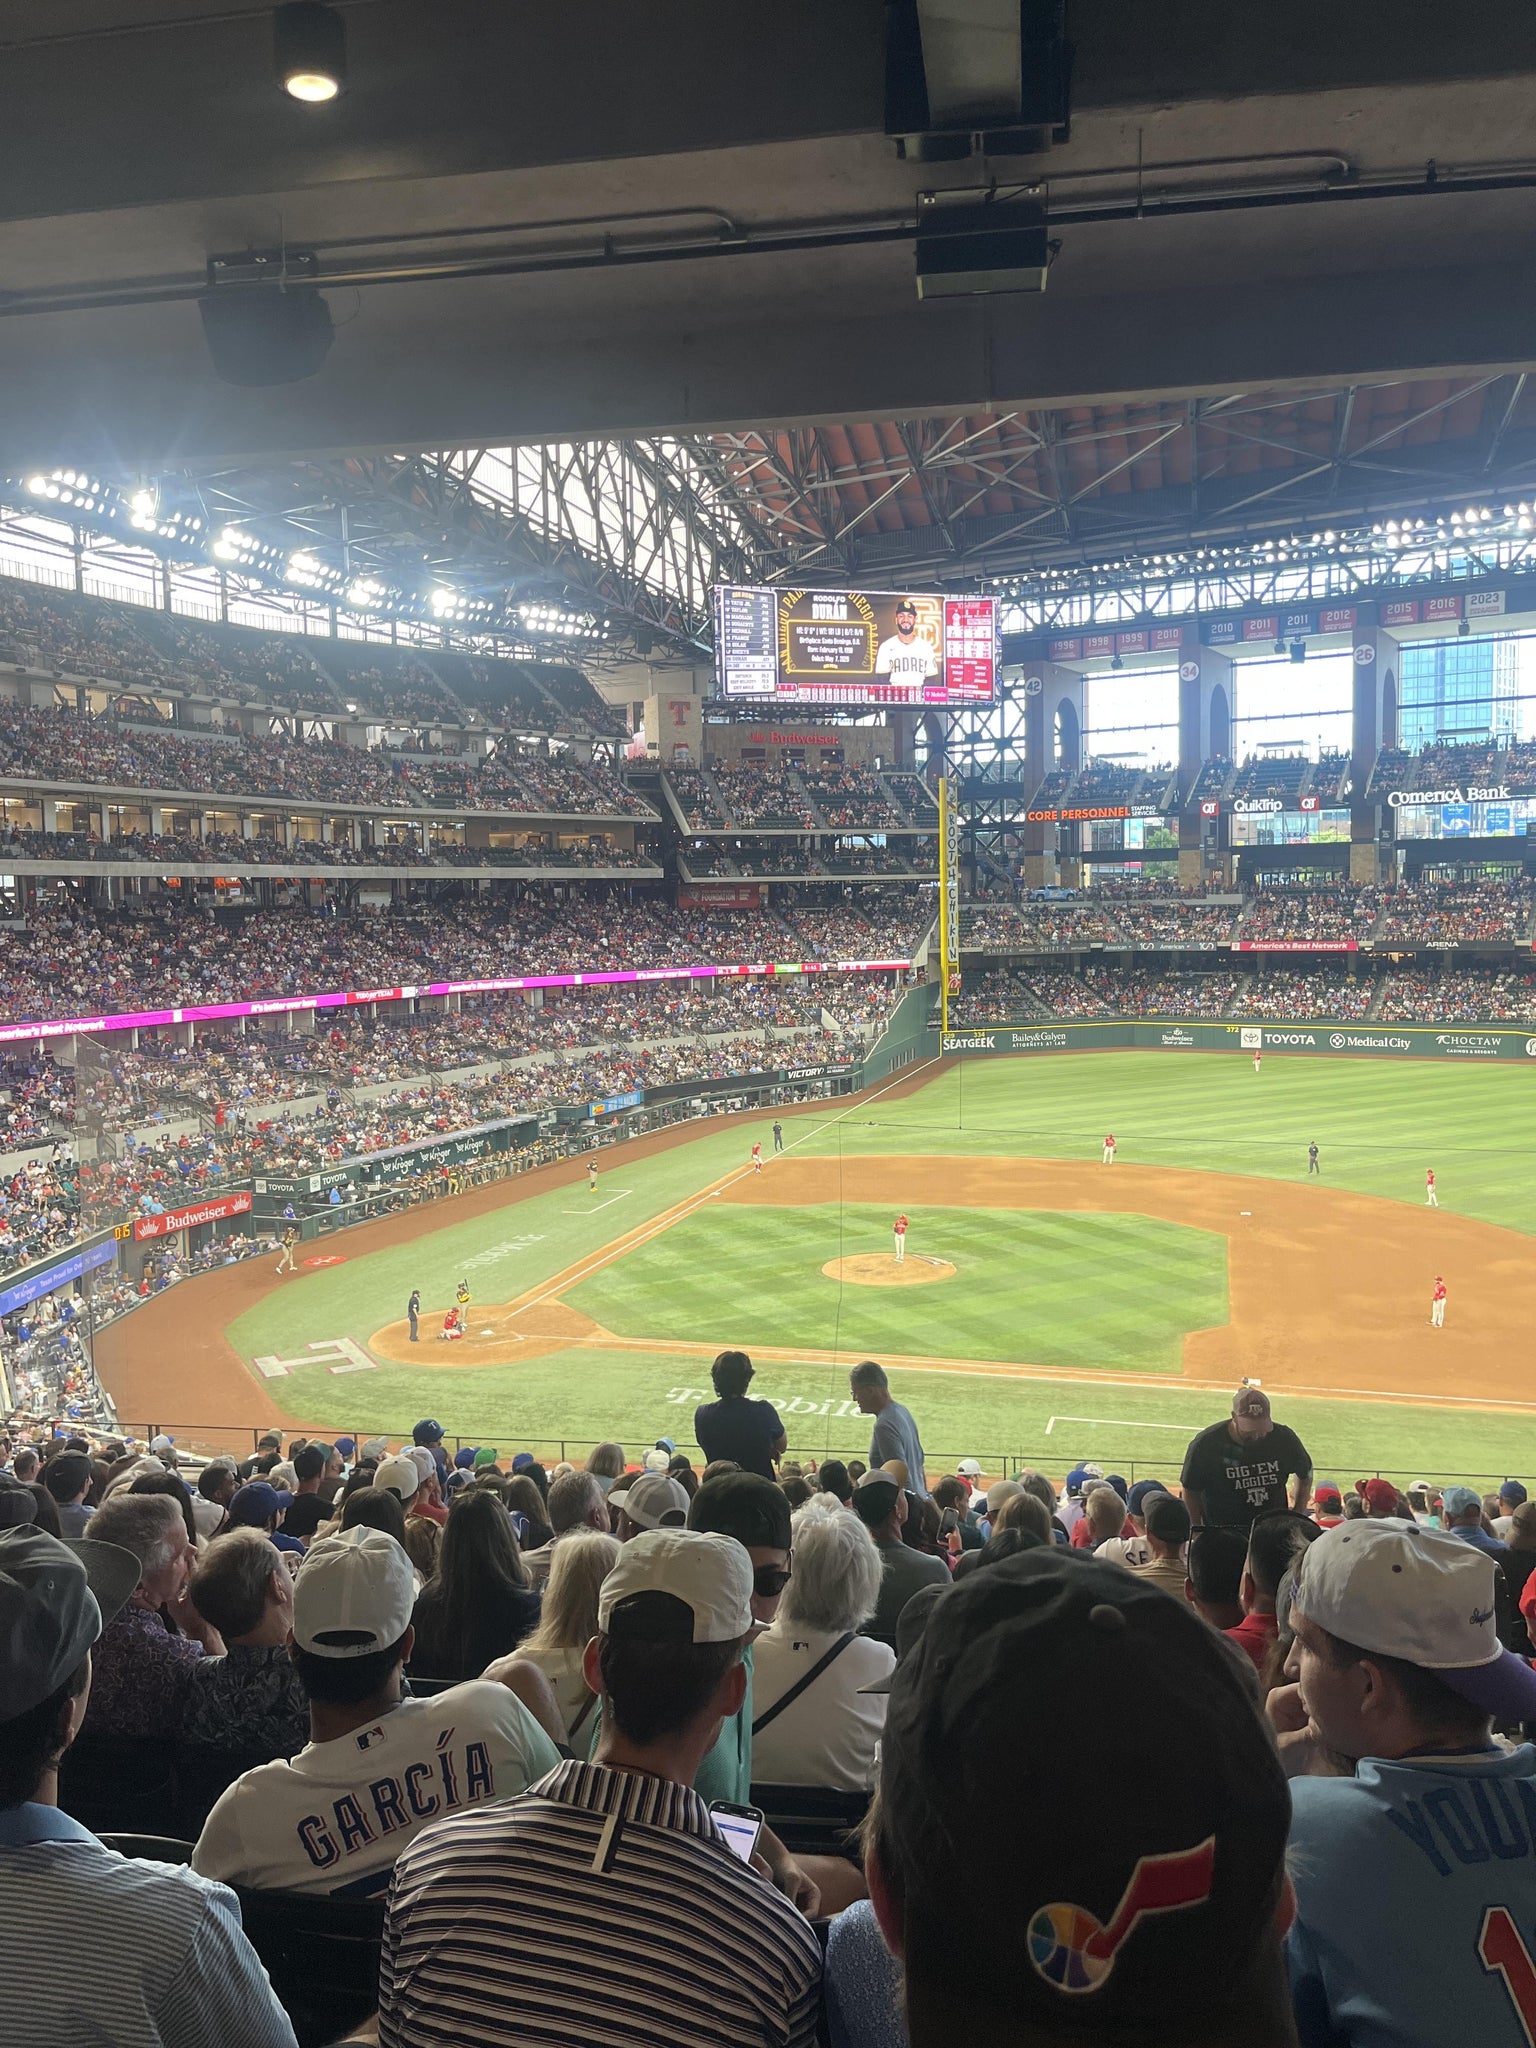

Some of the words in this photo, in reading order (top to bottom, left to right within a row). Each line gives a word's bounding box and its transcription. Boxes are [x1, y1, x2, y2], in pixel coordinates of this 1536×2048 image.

[1430, 598, 1455, 610] 2016
[1471, 593, 1500, 605] 2023
[1387, 602, 1412, 614] 2015
[1287, 614, 1308, 626] 2011
[1326, 610, 1350, 621] 2012
[1211, 622, 1233, 634] 2010
[1250, 618, 1270, 630] 2011
[1122, 632, 1143, 643] 1999
[1157, 629, 1179, 640] 2010
[1054, 640, 1074, 650] 1996
[1088, 637, 1109, 647] 1998
[1356, 649, 1373, 661] 26
[1182, 666, 1197, 678] 34
[1026, 681, 1041, 692] 42
[669, 701, 691, 727] T
[769, 731, 838, 745] Budweiser
[1467, 786, 1511, 801] Bank
[1202, 802, 1216, 814] QT
[1233, 799, 1283, 813] QuikTrip
[1302, 797, 1316, 810] QT
[1028, 810, 1058, 821] CORE
[1061, 806, 1131, 820] PERSONNEL
[41, 1024, 64, 1034] Best
[65, 1020, 106, 1033] Network
[943, 1036, 995, 1051] SEATGEEK
[1265, 1033, 1316, 1045] TOYOTA
[1347, 1036, 1388, 1048] Medical
[1389, 1037, 1411, 1050] City
[1436, 1034, 1501, 1046] CHOCTAW
[787, 1067, 821, 1080] VICTORY
[464, 1137, 485, 1155] Kroger
[429, 1146, 451, 1165] Kroger
[391, 1156, 415, 1175] Kroger
[322, 1172, 348, 1184] TOYOTA
[267, 1183, 295, 1192] TOYOTA
[165, 1206, 227, 1231] Budweiser
[1226, 1465, 1251, 1479] GIG
[1235, 1473, 1278, 1490] AGGIES
[297, 1727, 496, 1869] GARCÍA
